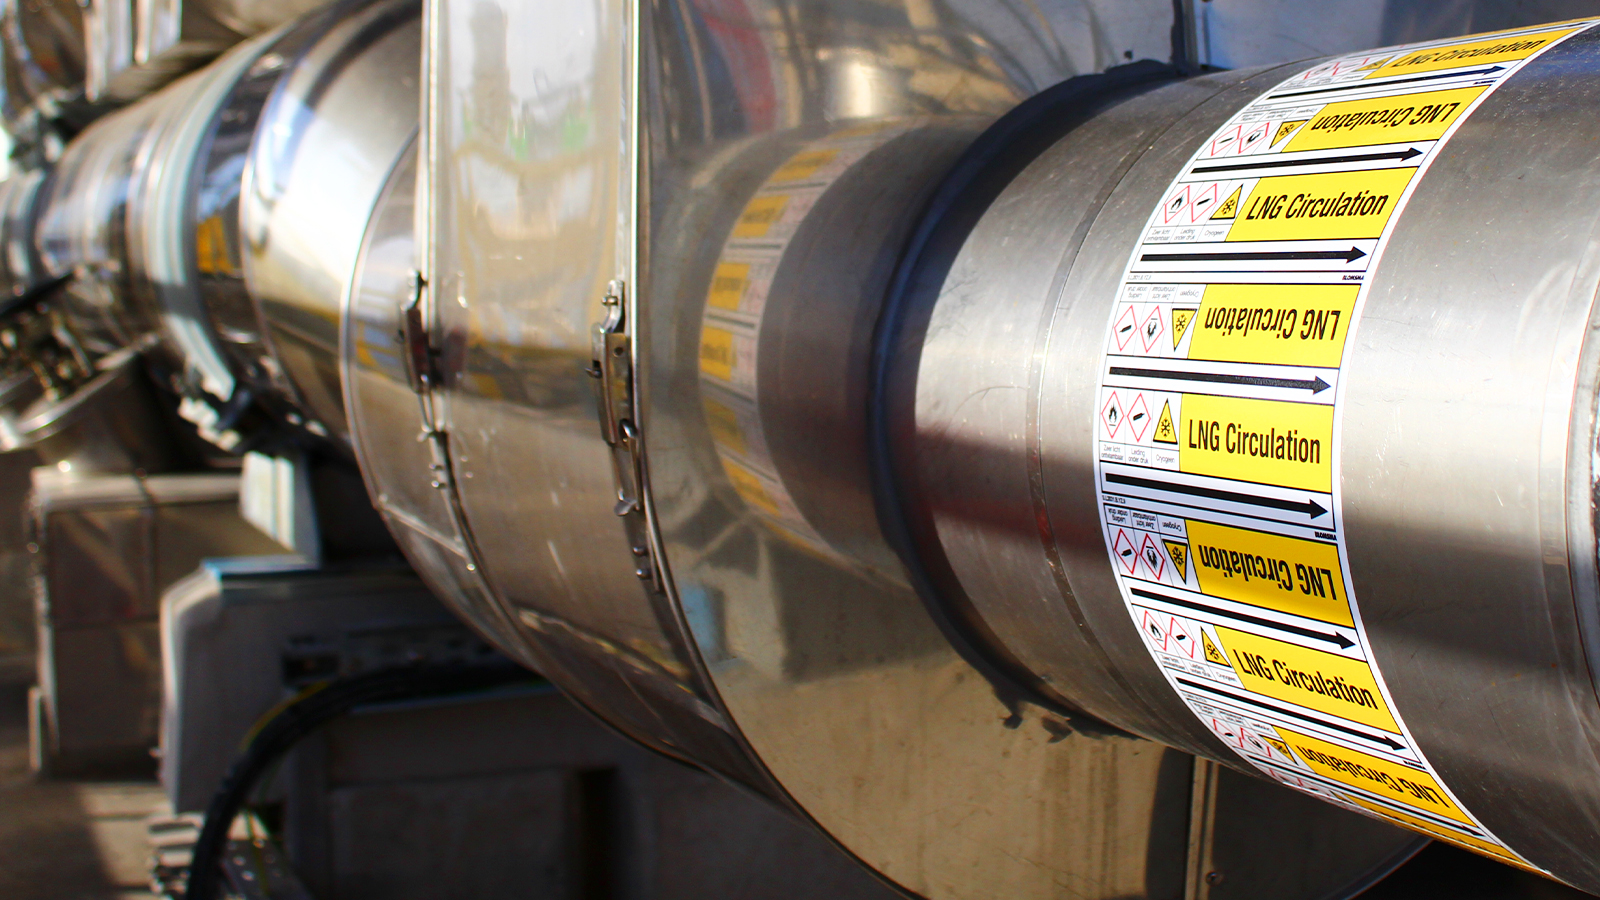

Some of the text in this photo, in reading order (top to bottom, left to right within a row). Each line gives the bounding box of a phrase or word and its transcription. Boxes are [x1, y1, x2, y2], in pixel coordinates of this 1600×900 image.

[1391, 40, 1548, 68] LNG Circulation
[1312, 102, 1460, 132] LNG Circulation
[1246, 190, 1388, 220] LNG Circulation
[1205, 307, 1341, 340] LNG Circulation
[1189, 419, 1320, 464] LNG Circulation
[1199, 544, 1338, 600] LNG Circulation
[1233, 649, 1379, 710] LNG Circulation
[1300, 745, 1452, 808] LNG Circulation
